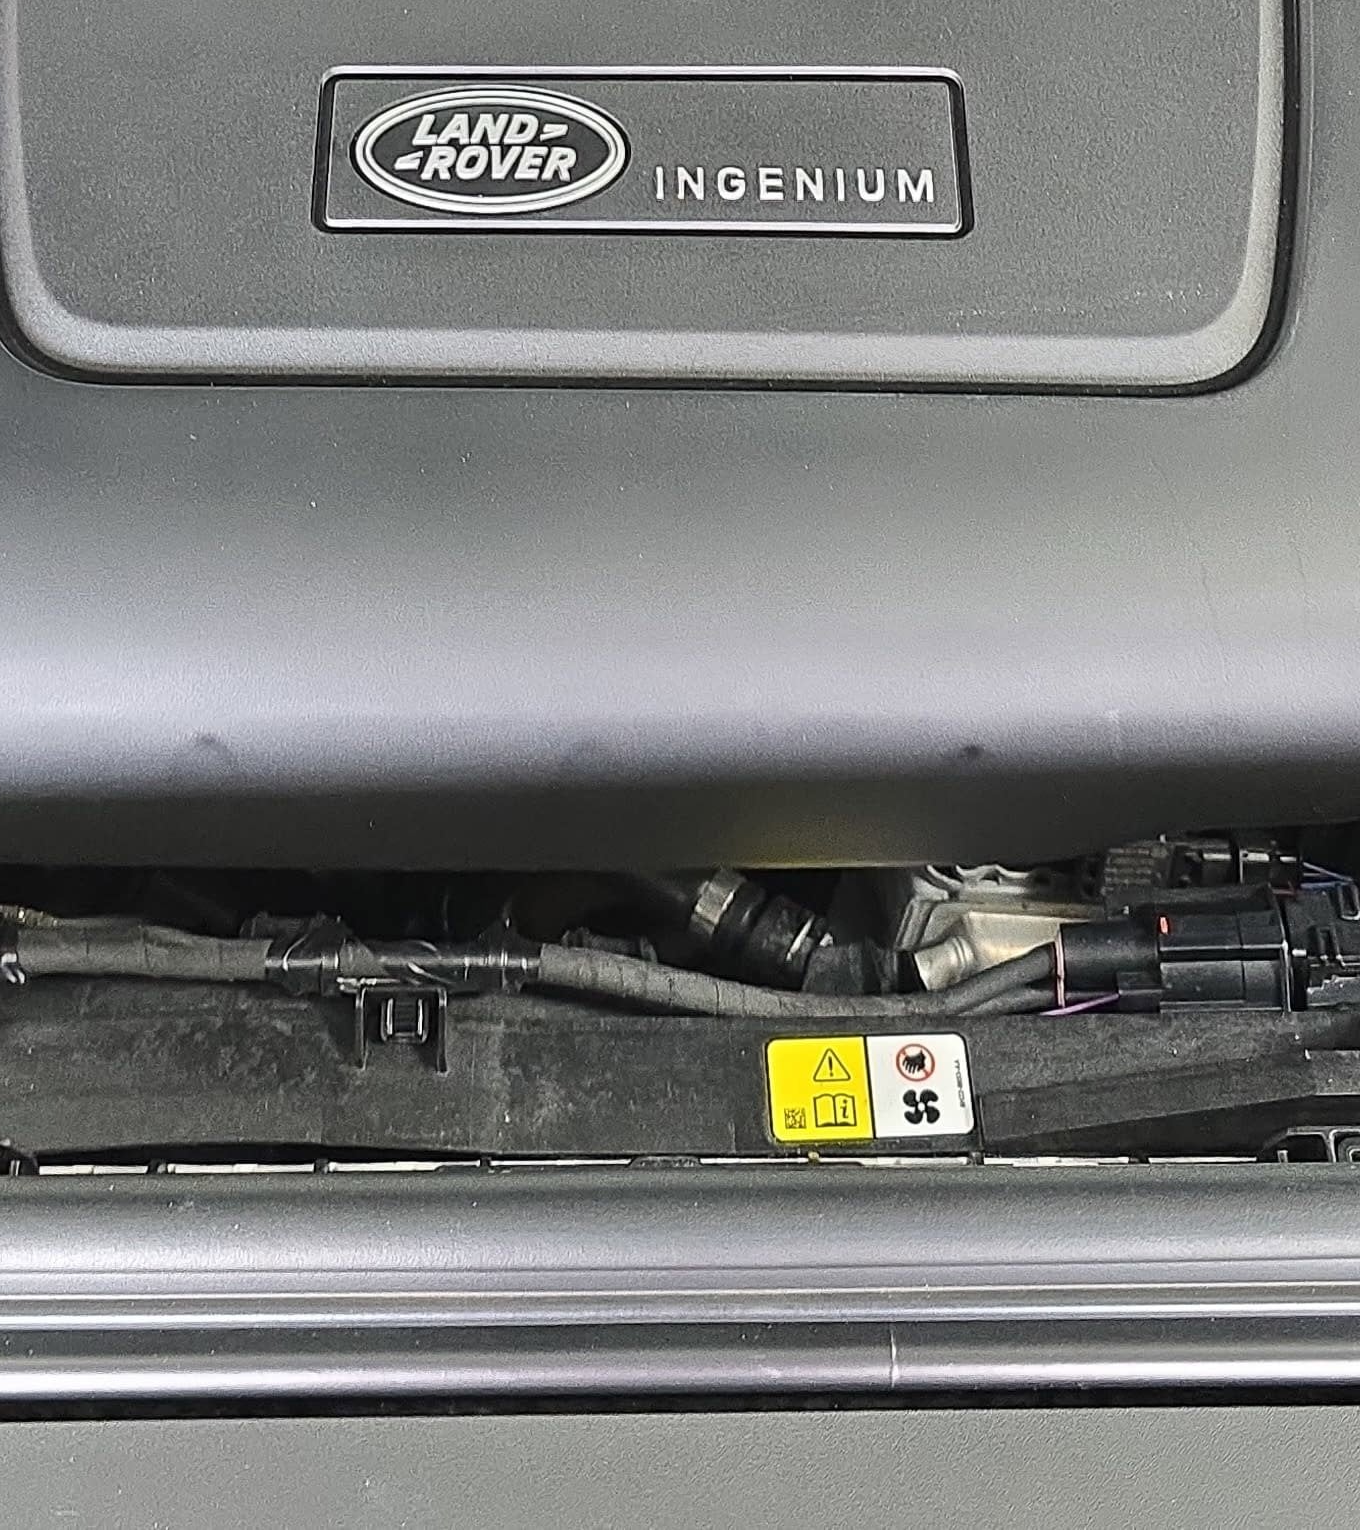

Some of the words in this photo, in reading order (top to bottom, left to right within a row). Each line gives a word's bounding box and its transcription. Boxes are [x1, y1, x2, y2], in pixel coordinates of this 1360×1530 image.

[411, 112, 538, 146] LAND
[420, 145, 578, 182] ROVER
[654, 165, 935, 204] INGENIUM
